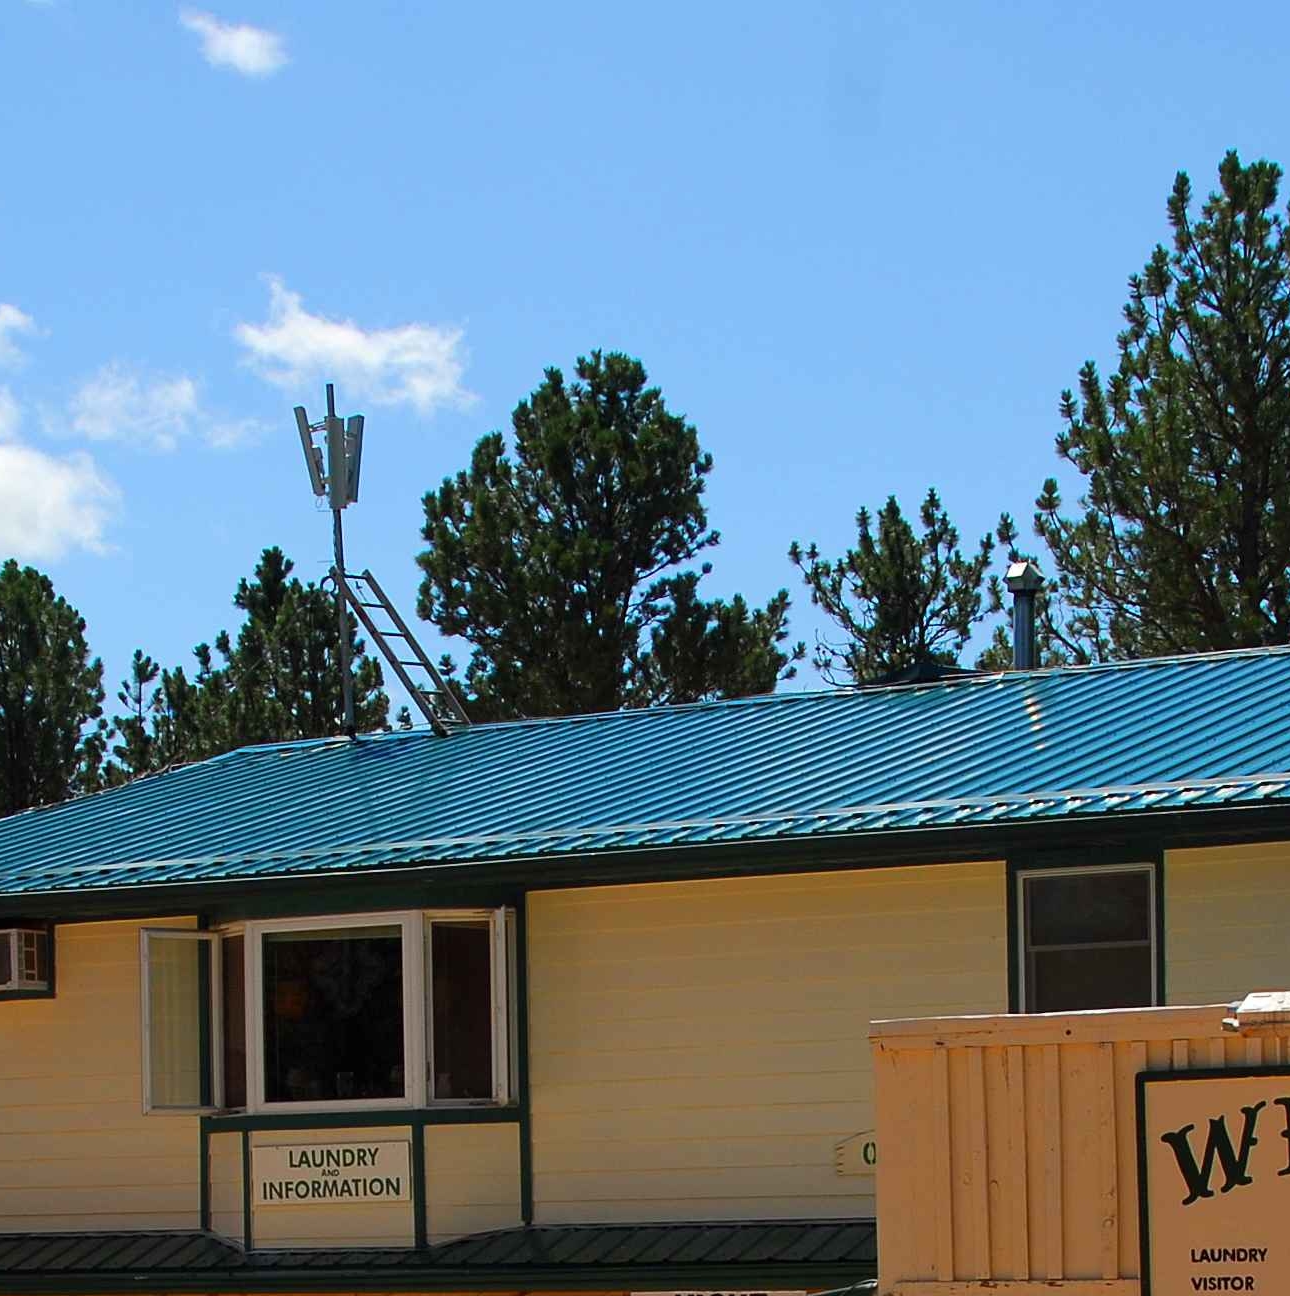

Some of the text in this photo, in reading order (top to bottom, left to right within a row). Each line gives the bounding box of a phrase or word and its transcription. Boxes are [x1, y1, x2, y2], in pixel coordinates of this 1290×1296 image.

[288, 1147, 380, 1168] LAUNDRY
[321, 1169, 340, 1178] AND
[262, 1177, 401, 1200] INFORMATION
[1190, 1246, 1269, 1264] LAUNDRY
[1191, 1275, 1256, 1292] VISITOR
